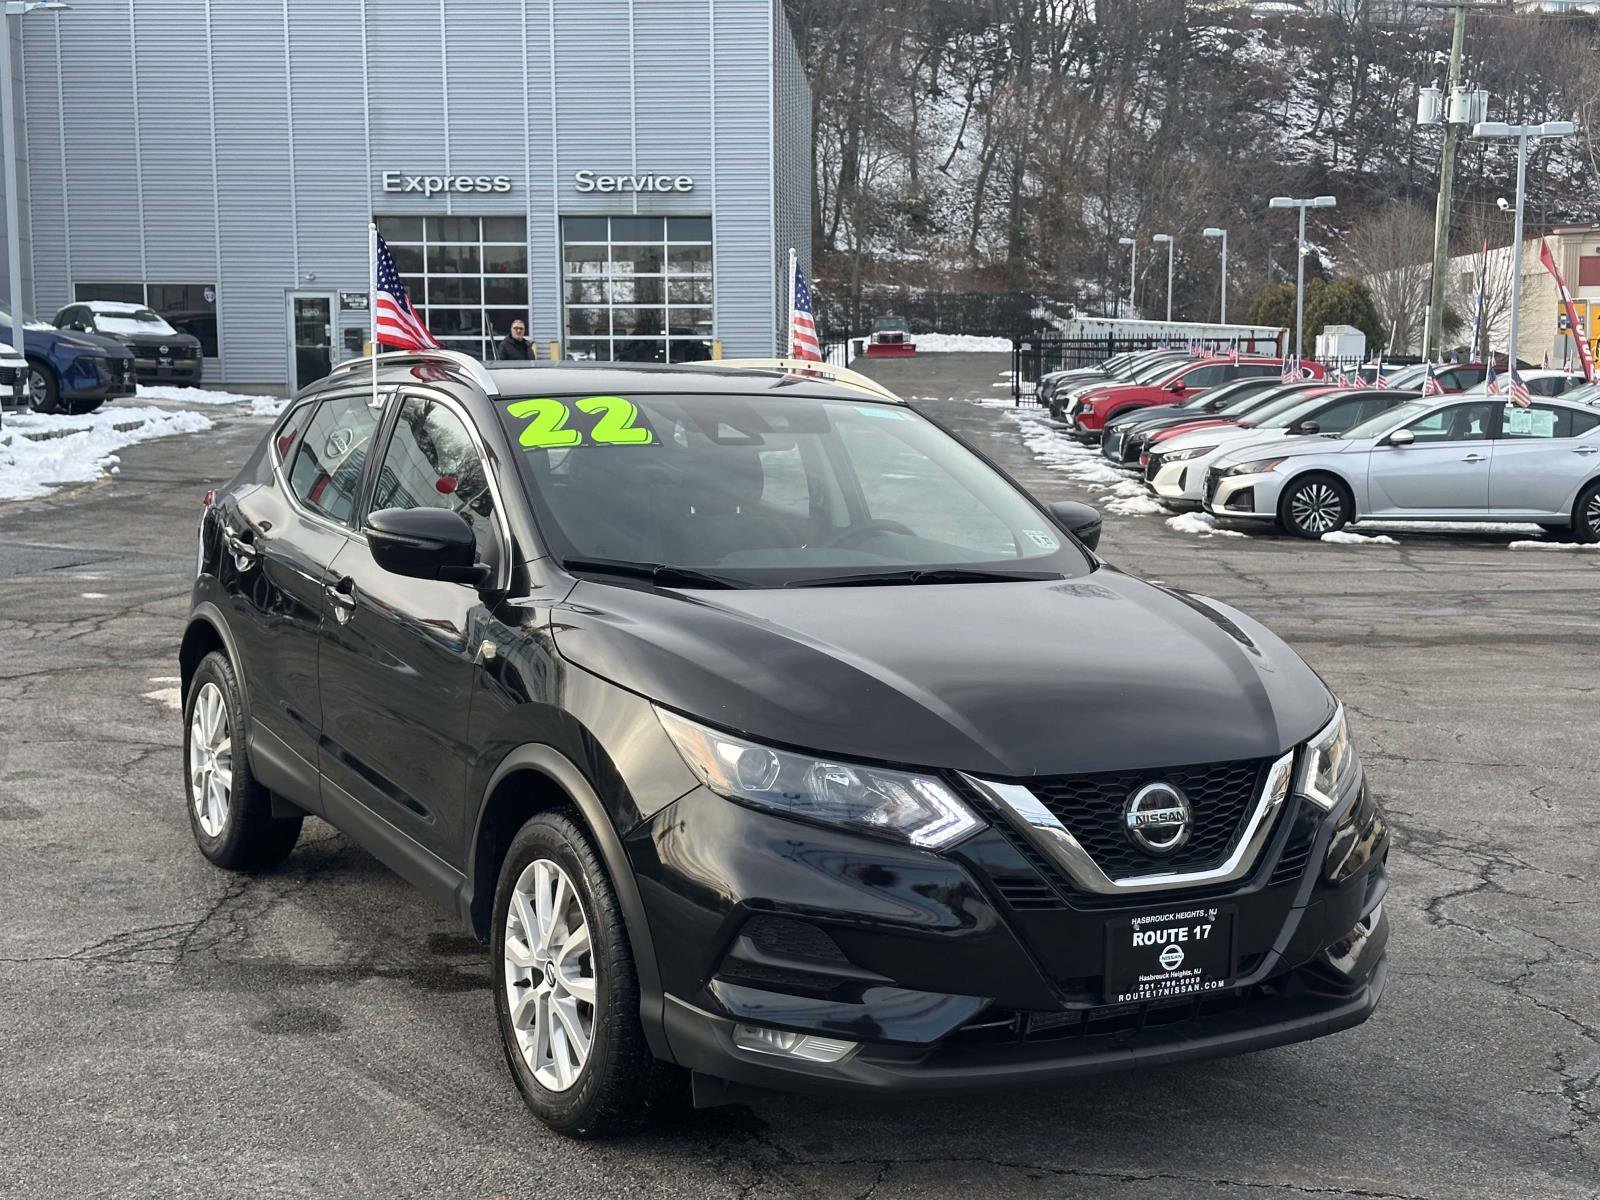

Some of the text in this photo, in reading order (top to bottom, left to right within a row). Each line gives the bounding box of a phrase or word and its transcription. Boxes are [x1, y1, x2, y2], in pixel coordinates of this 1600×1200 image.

[382, 169, 694, 197] Express Service
[506, 396, 653, 449] 22
[1135, 810, 1185, 825] NISSAN
[1131, 913, 1174, 925] HASBROUCK
[1208, 908, 1218, 916] NJ
[1132, 924, 1212, 947] ROUTE 17
[1161, 953, 1183, 961] NISSAN
[1139, 972, 1169, 982] Hasbrouck
[1118, 980, 1225, 1002] ROUTE17NISSAN.COM
